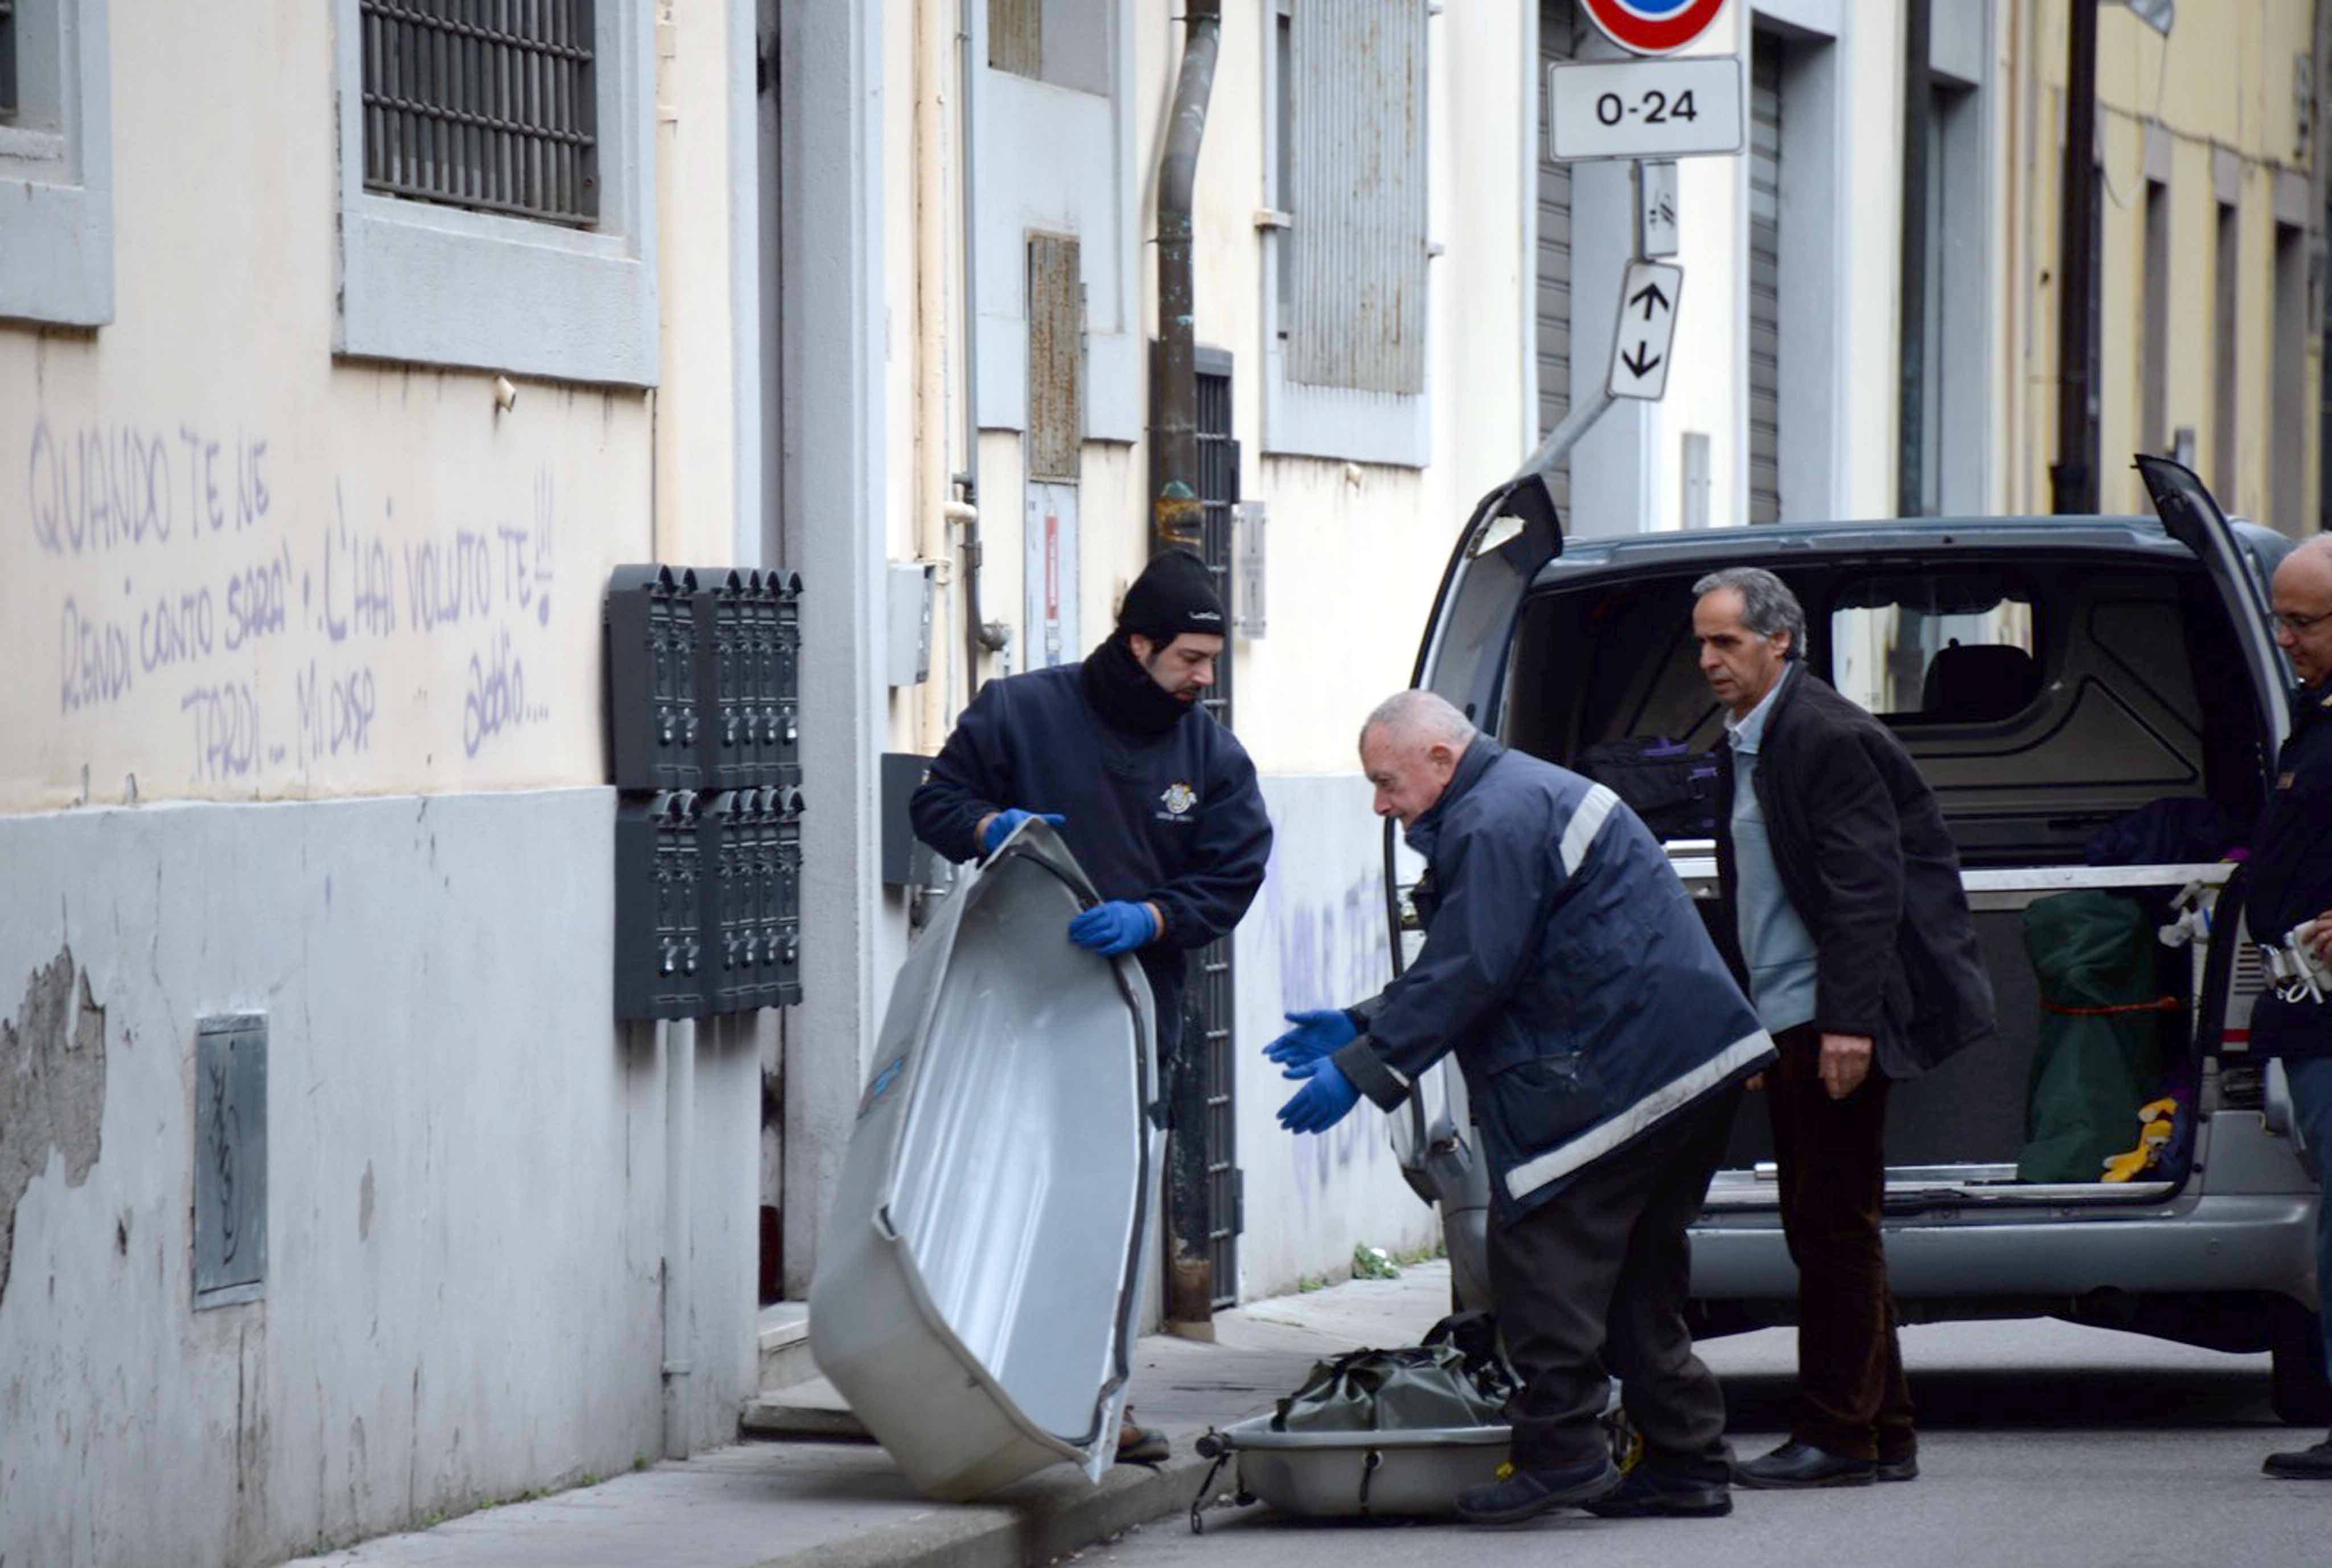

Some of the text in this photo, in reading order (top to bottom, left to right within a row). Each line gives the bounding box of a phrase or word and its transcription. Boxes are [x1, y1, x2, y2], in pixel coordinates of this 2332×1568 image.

[1597, 90, 1697, 126] 0-24
[29, 419, 270, 556] QUANDO TE NE
[404, 529, 490, 631] VOLUTO
